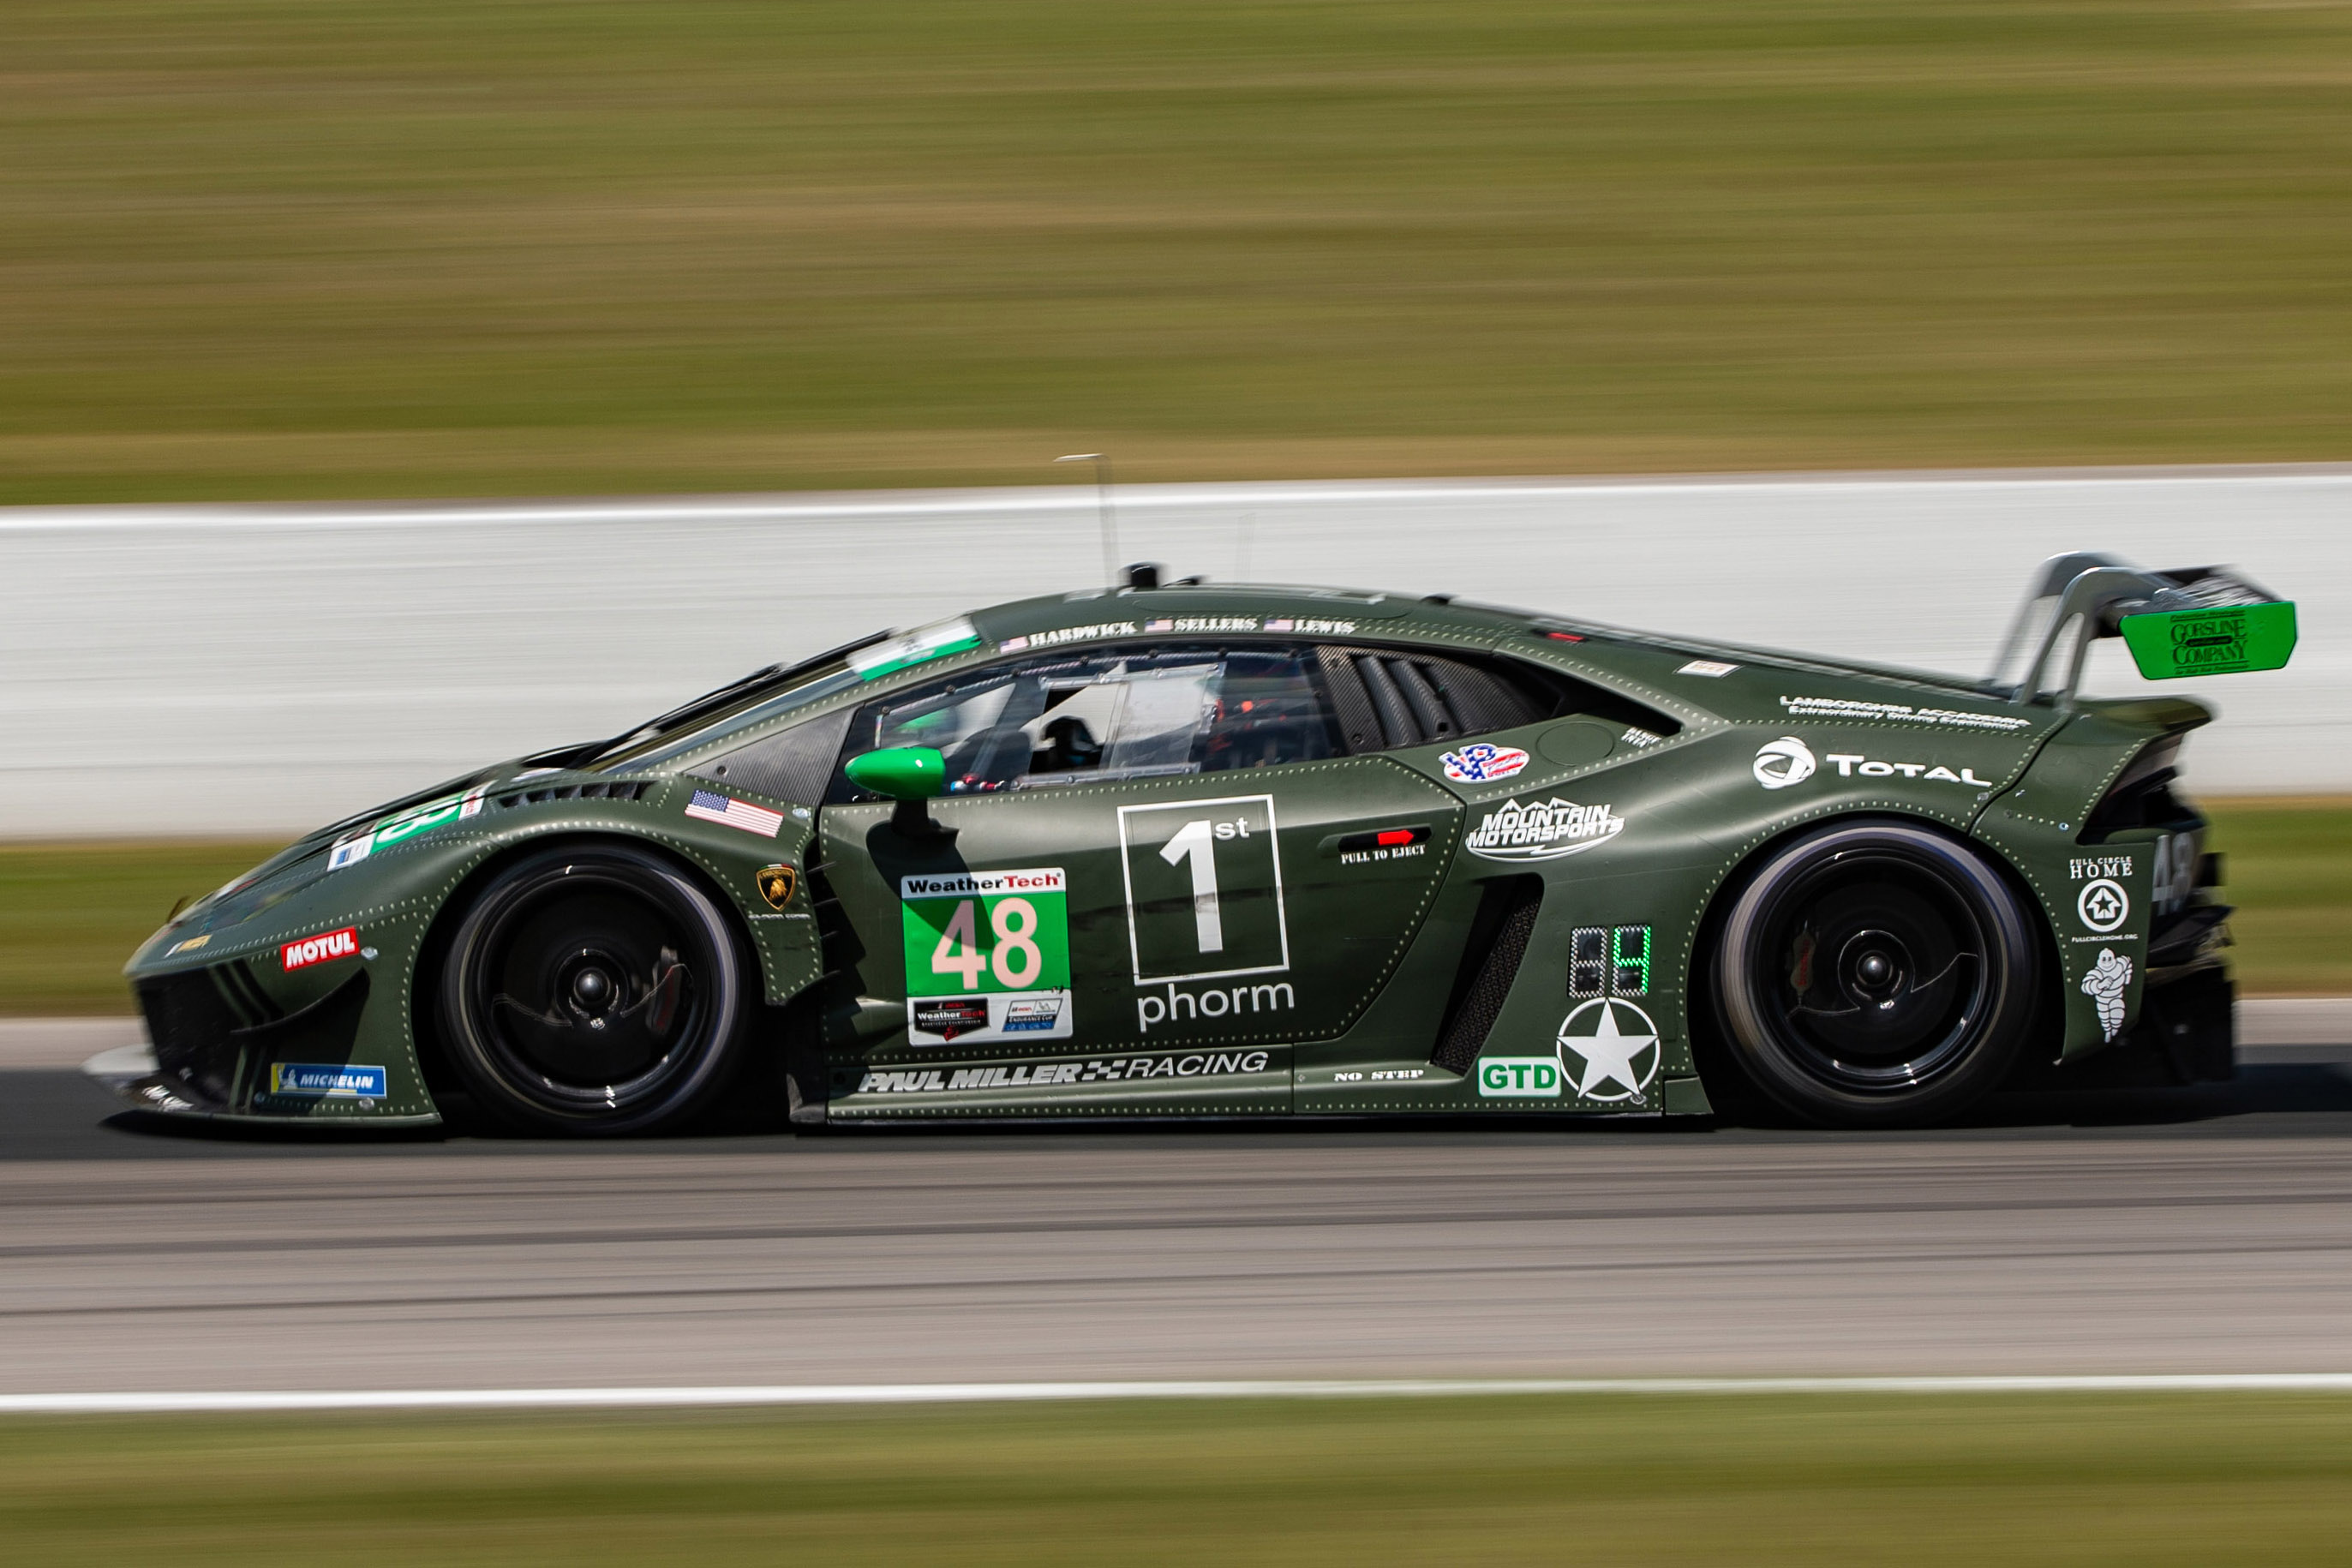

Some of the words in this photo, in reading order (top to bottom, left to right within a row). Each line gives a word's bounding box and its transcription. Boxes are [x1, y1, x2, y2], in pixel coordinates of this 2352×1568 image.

[1029, 621, 1138, 646] HARDWICK
[1174, 617, 1258, 632] SELLERS
[1295, 619, 1356, 635] LEWIS
[1825, 753, 1993, 787] TOTAL
[1480, 804, 1612, 833] MOUNTAIN
[1467, 817, 1625, 848] MOTORSPORTS
[1340, 851, 1370, 865] PULL
[1373, 849, 1389, 861] TO
[1391, 844, 1426, 859] EJECT
[2069, 858, 2094, 866] FULL
[2097, 855, 2132, 865] CIRCLE
[2069, 862, 2134, 880] HOME
[285, 931, 356, 969] MOTUL
[931, 896, 1043, 990] 48
[1136, 982, 1295, 1033] phorm
[300, 1074, 374, 1089] MICHELIN
[859, 1070, 945, 1092] PAUL
[948, 1062, 1083, 1091] MILLER
[1124, 1051, 1269, 1079] RACING
[1334, 1072, 1363, 1081] NO
[1371, 1068, 1424, 1080] STEP
[1482, 1063, 1557, 1089] GTD
